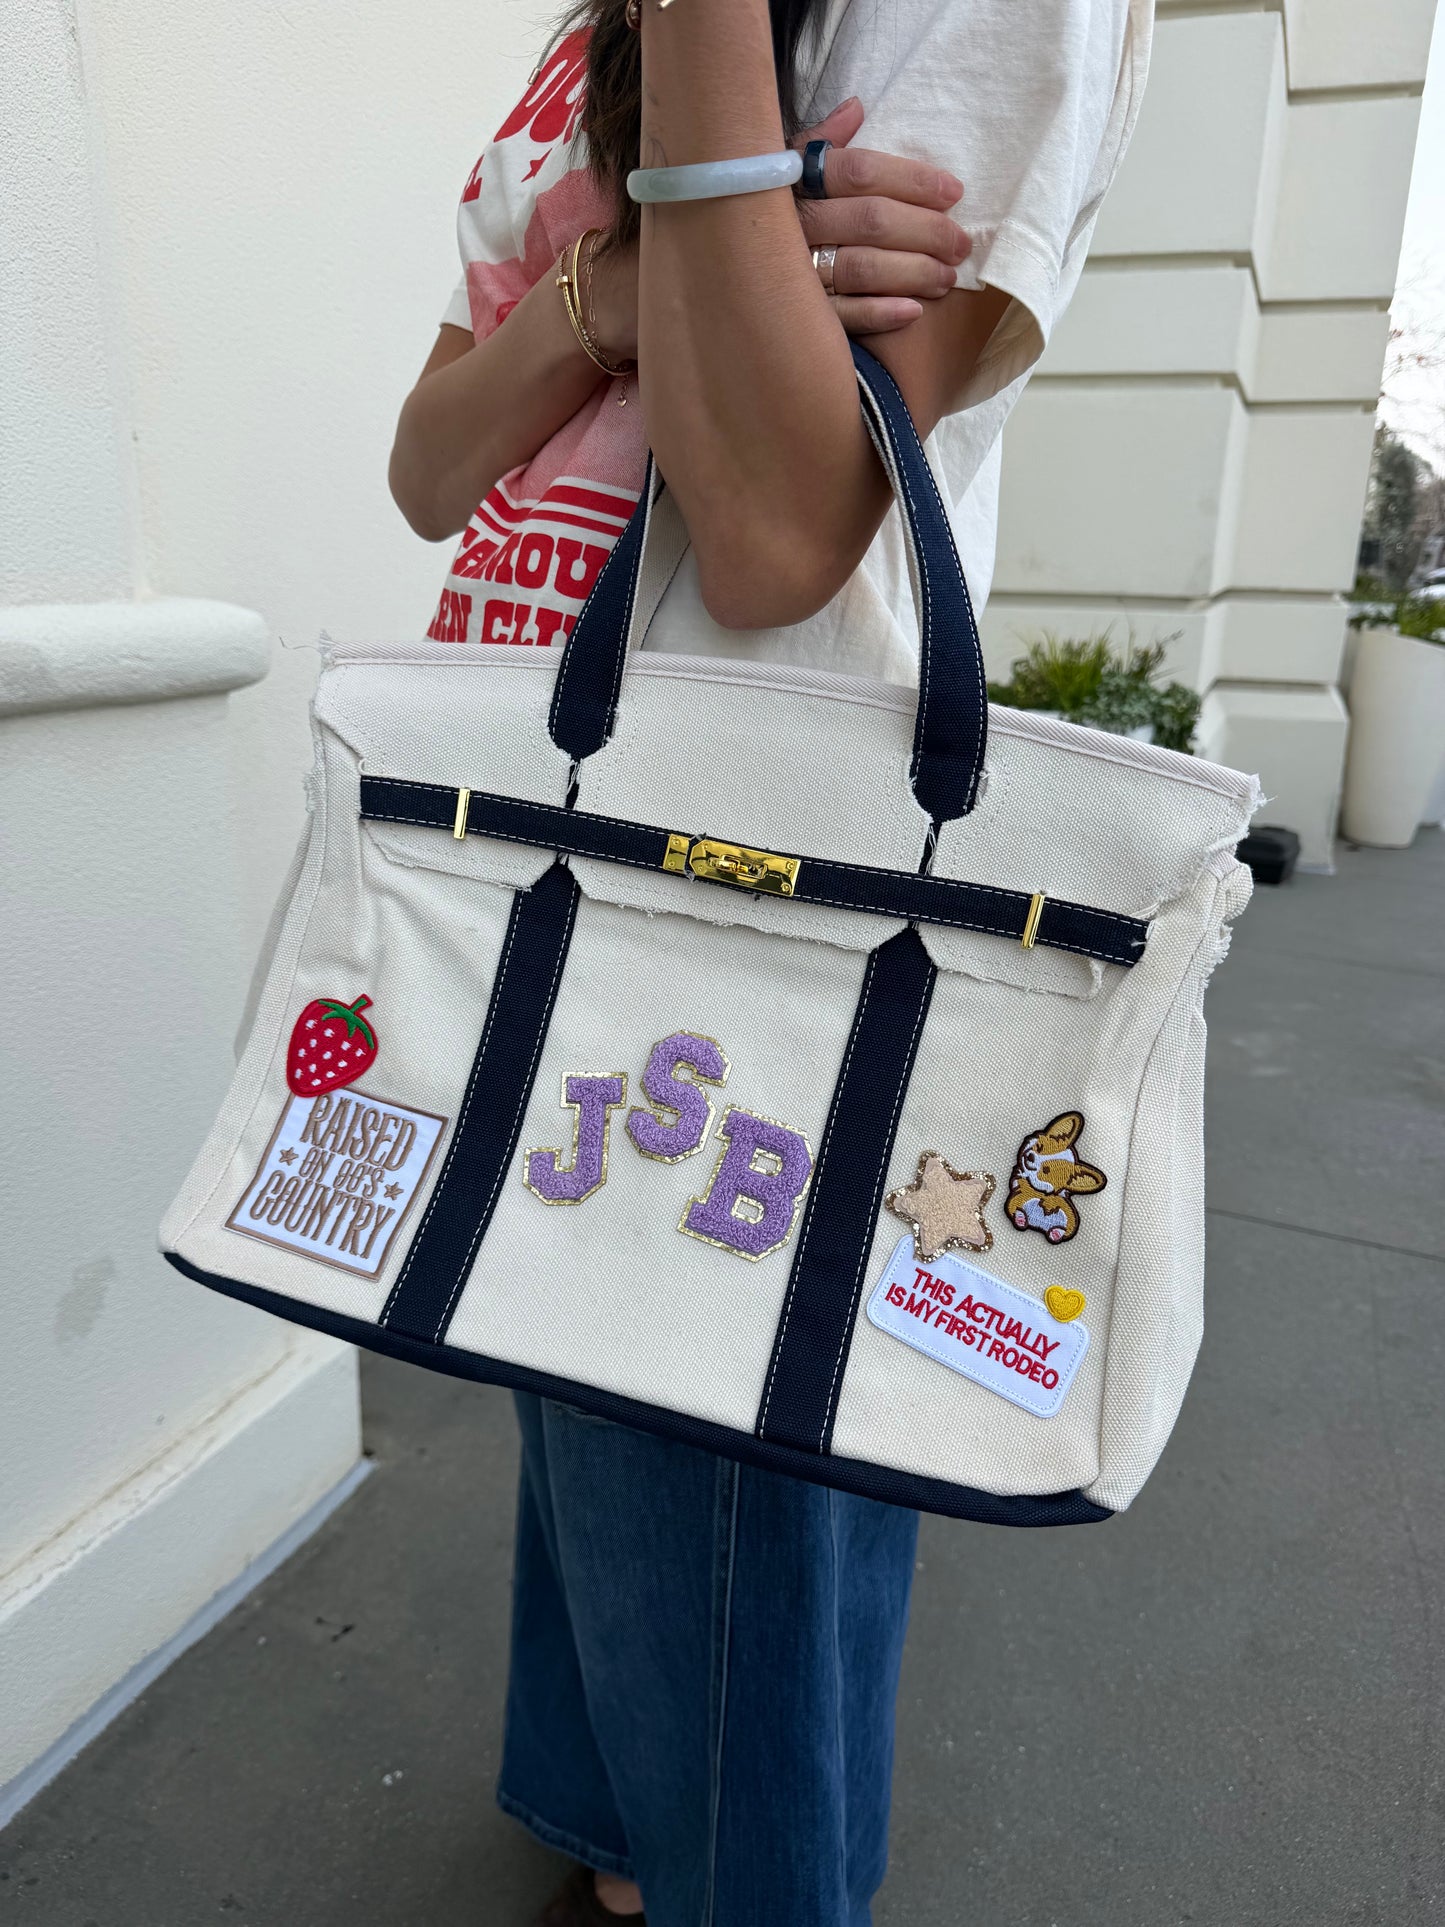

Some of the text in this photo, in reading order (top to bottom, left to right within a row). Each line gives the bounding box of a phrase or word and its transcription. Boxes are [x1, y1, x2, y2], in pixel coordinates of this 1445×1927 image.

[298, 1146, 336, 1182] ON
[300, 1095, 418, 1172] RAISED
[523, 1029, 816, 1263] JSB
[249, 1170, 396, 1260] COUNTRY
[884, 1282, 1060, 1390] IS MY FIRST RODEO
[912, 1267, 1061, 1361] THIS ACTUALLY
